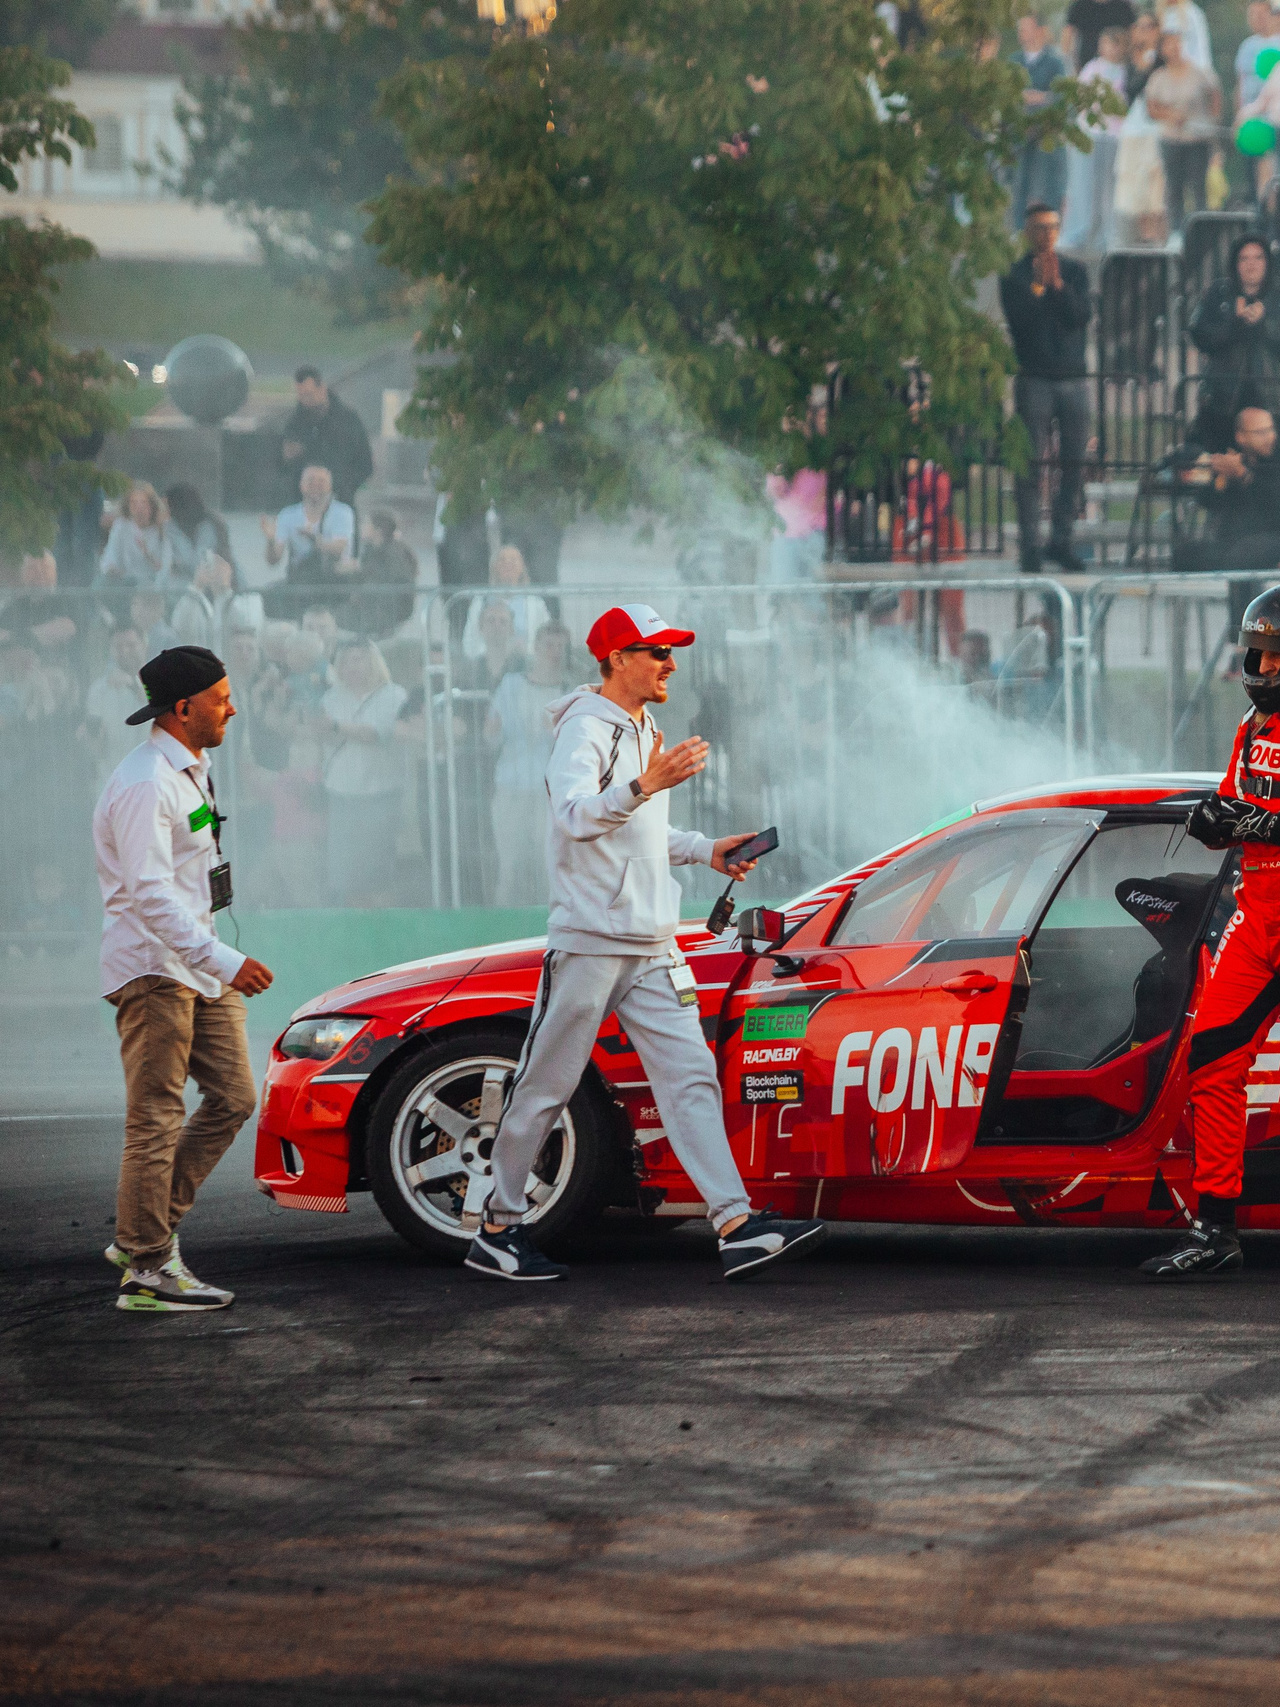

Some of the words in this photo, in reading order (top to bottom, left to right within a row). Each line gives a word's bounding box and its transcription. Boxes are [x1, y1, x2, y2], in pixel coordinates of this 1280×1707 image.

[1126, 889, 1180, 912] KAPSHAI
[745, 1074, 793, 1087] Blockchain
[746, 1088, 776, 1101] Sports
